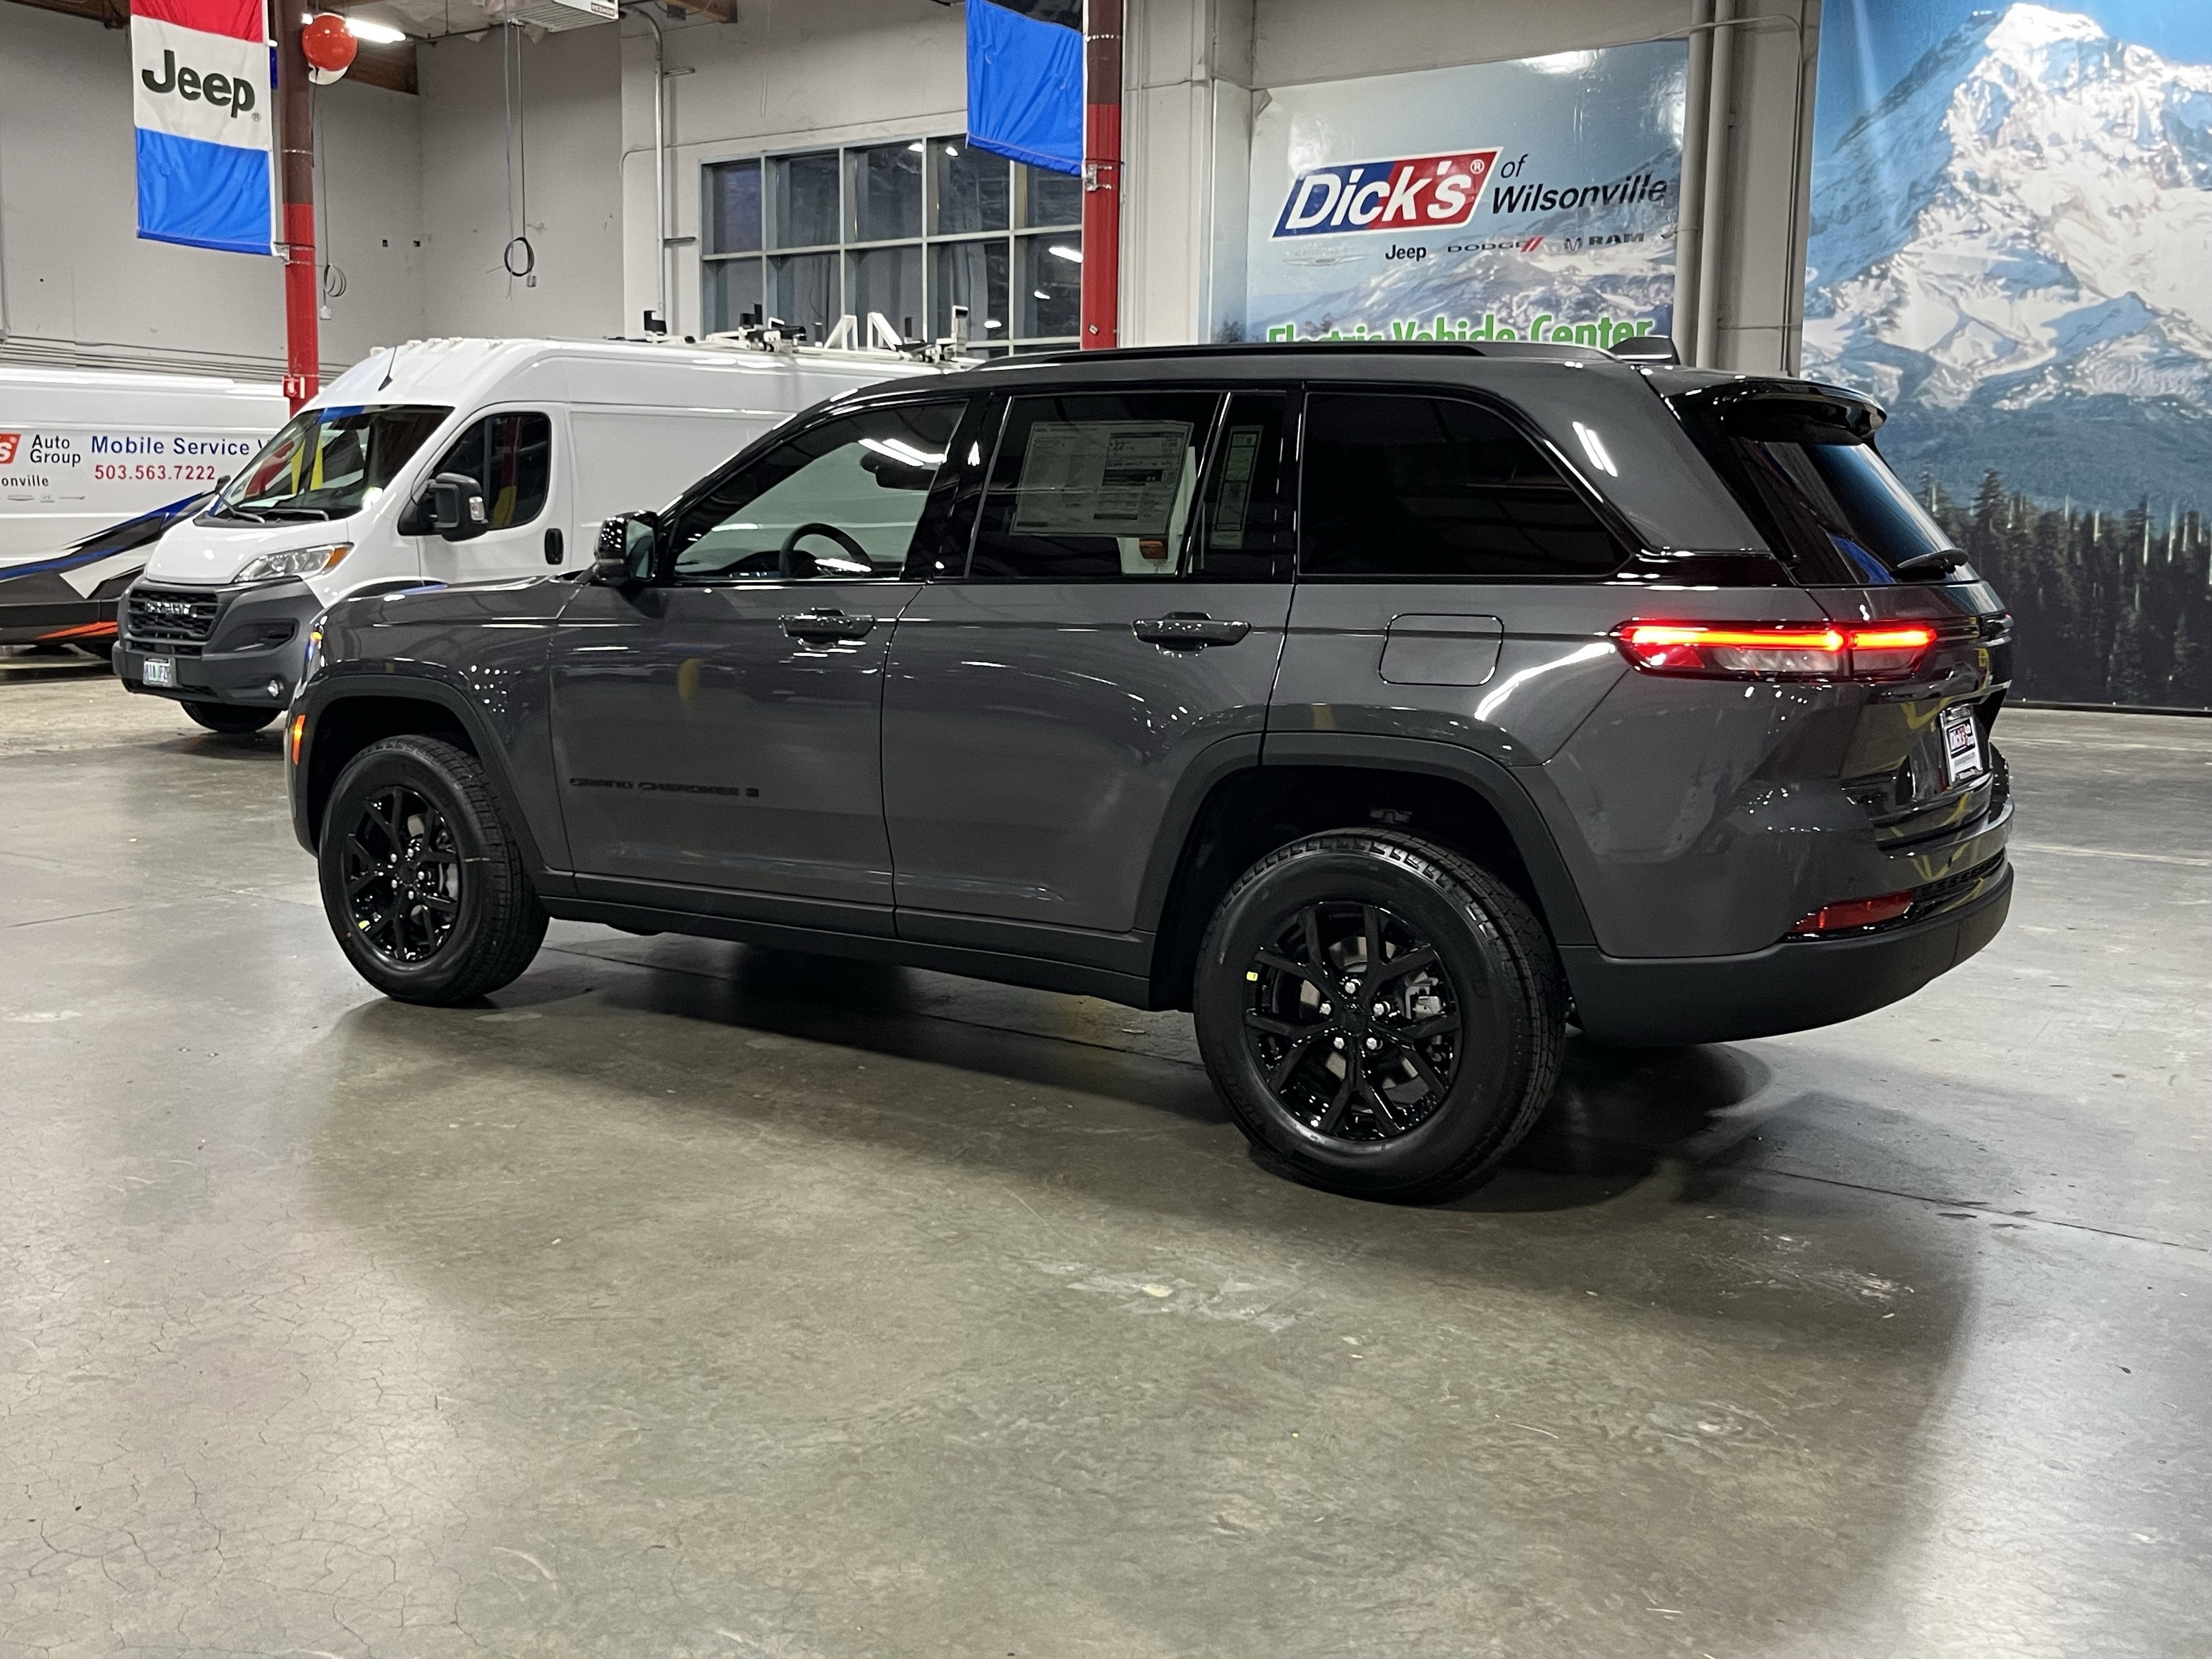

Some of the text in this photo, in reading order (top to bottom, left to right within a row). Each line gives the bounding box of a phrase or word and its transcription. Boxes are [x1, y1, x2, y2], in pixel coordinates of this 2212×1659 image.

[142, 49, 255, 118] Jeep
[1500, 154, 1528, 178] of
[1493, 172, 1667, 215] Wilsonville
[1385, 245, 1426, 261] Jeep
[1589, 233, 1644, 245] RAM
[1393, 314, 1516, 341] Vhil
[32, 434, 70, 449] Auto
[92, 436, 165, 454] Mobile
[173, 437, 250, 455] Service
[30, 449, 81, 467] Group
[94, 465, 215, 480] 503.563.7222
